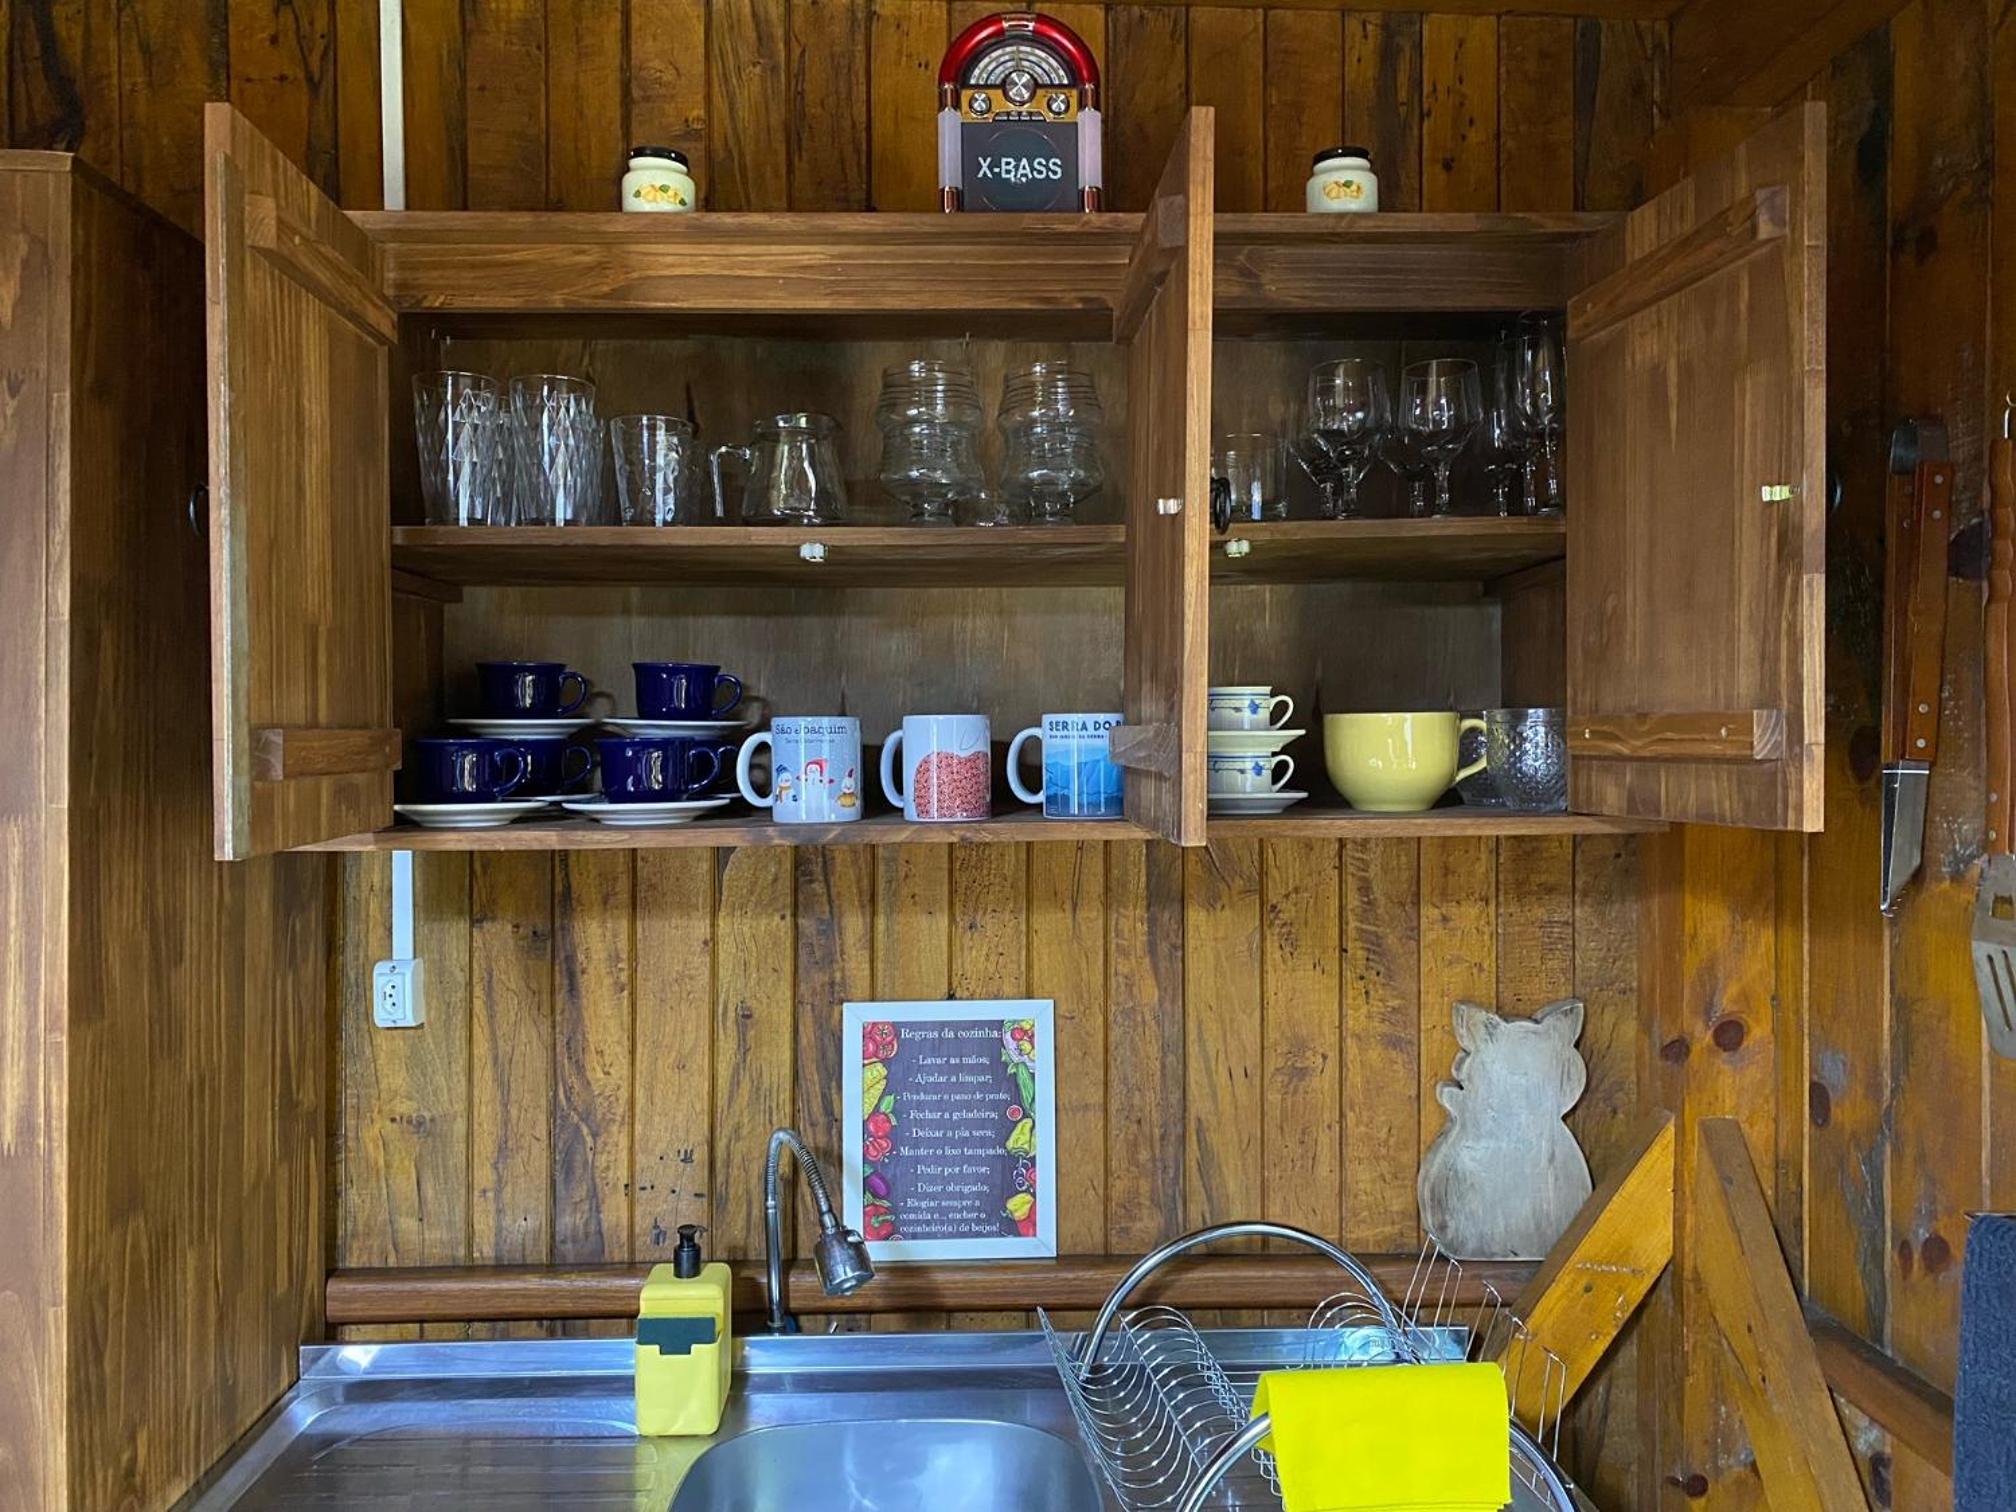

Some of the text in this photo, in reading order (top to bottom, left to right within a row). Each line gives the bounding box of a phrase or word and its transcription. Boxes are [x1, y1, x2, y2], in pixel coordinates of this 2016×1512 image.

[977, 157, 1062, 179] X-BASS
[1049, 720, 1088, 732] SERRA
[1094, 720, 1112, 731] DO
[901, 1028, 1001, 1041] Regras da cozinha:
[919, 1055, 947, 1065] Lavar
[949, 1057, 961, 1065] as
[962, 1055, 990, 1065] mãos;
[915, 1073, 948, 1085] Ajudar
[950, 1075, 957, 1083] a
[959, 1072, 993, 1085] limpar;
[951, 1093, 971, 1102] pano
[973, 1092, 983, 1100] de
[909, 1110, 942, 1119] Fechar
[944, 1111, 950, 1119] a
[952, 1110, 998, 1120] geladeira;
[912, 1127, 944, 1138] Deixar
[955, 1127, 970, 1139] pia
[900, 1146, 935, 1156] Manter
[944, 1146, 961, 1156] lixo
[917, 1165, 943, 1174] Pedir
[944, 1167, 960, 1176] por
[963, 1164, 990, 1174] favor;
[917, 1183, 943, 1193] Dizer
[945, 1182, 990, 1194] obrigado;
[906, 1198, 940, 1208] Elogiar
[941, 1200, 972, 1208] sempre
[900, 1211, 931, 1219] comida
[900, 1222, 1000, 1233] cozinheiro(a) de beijos!
